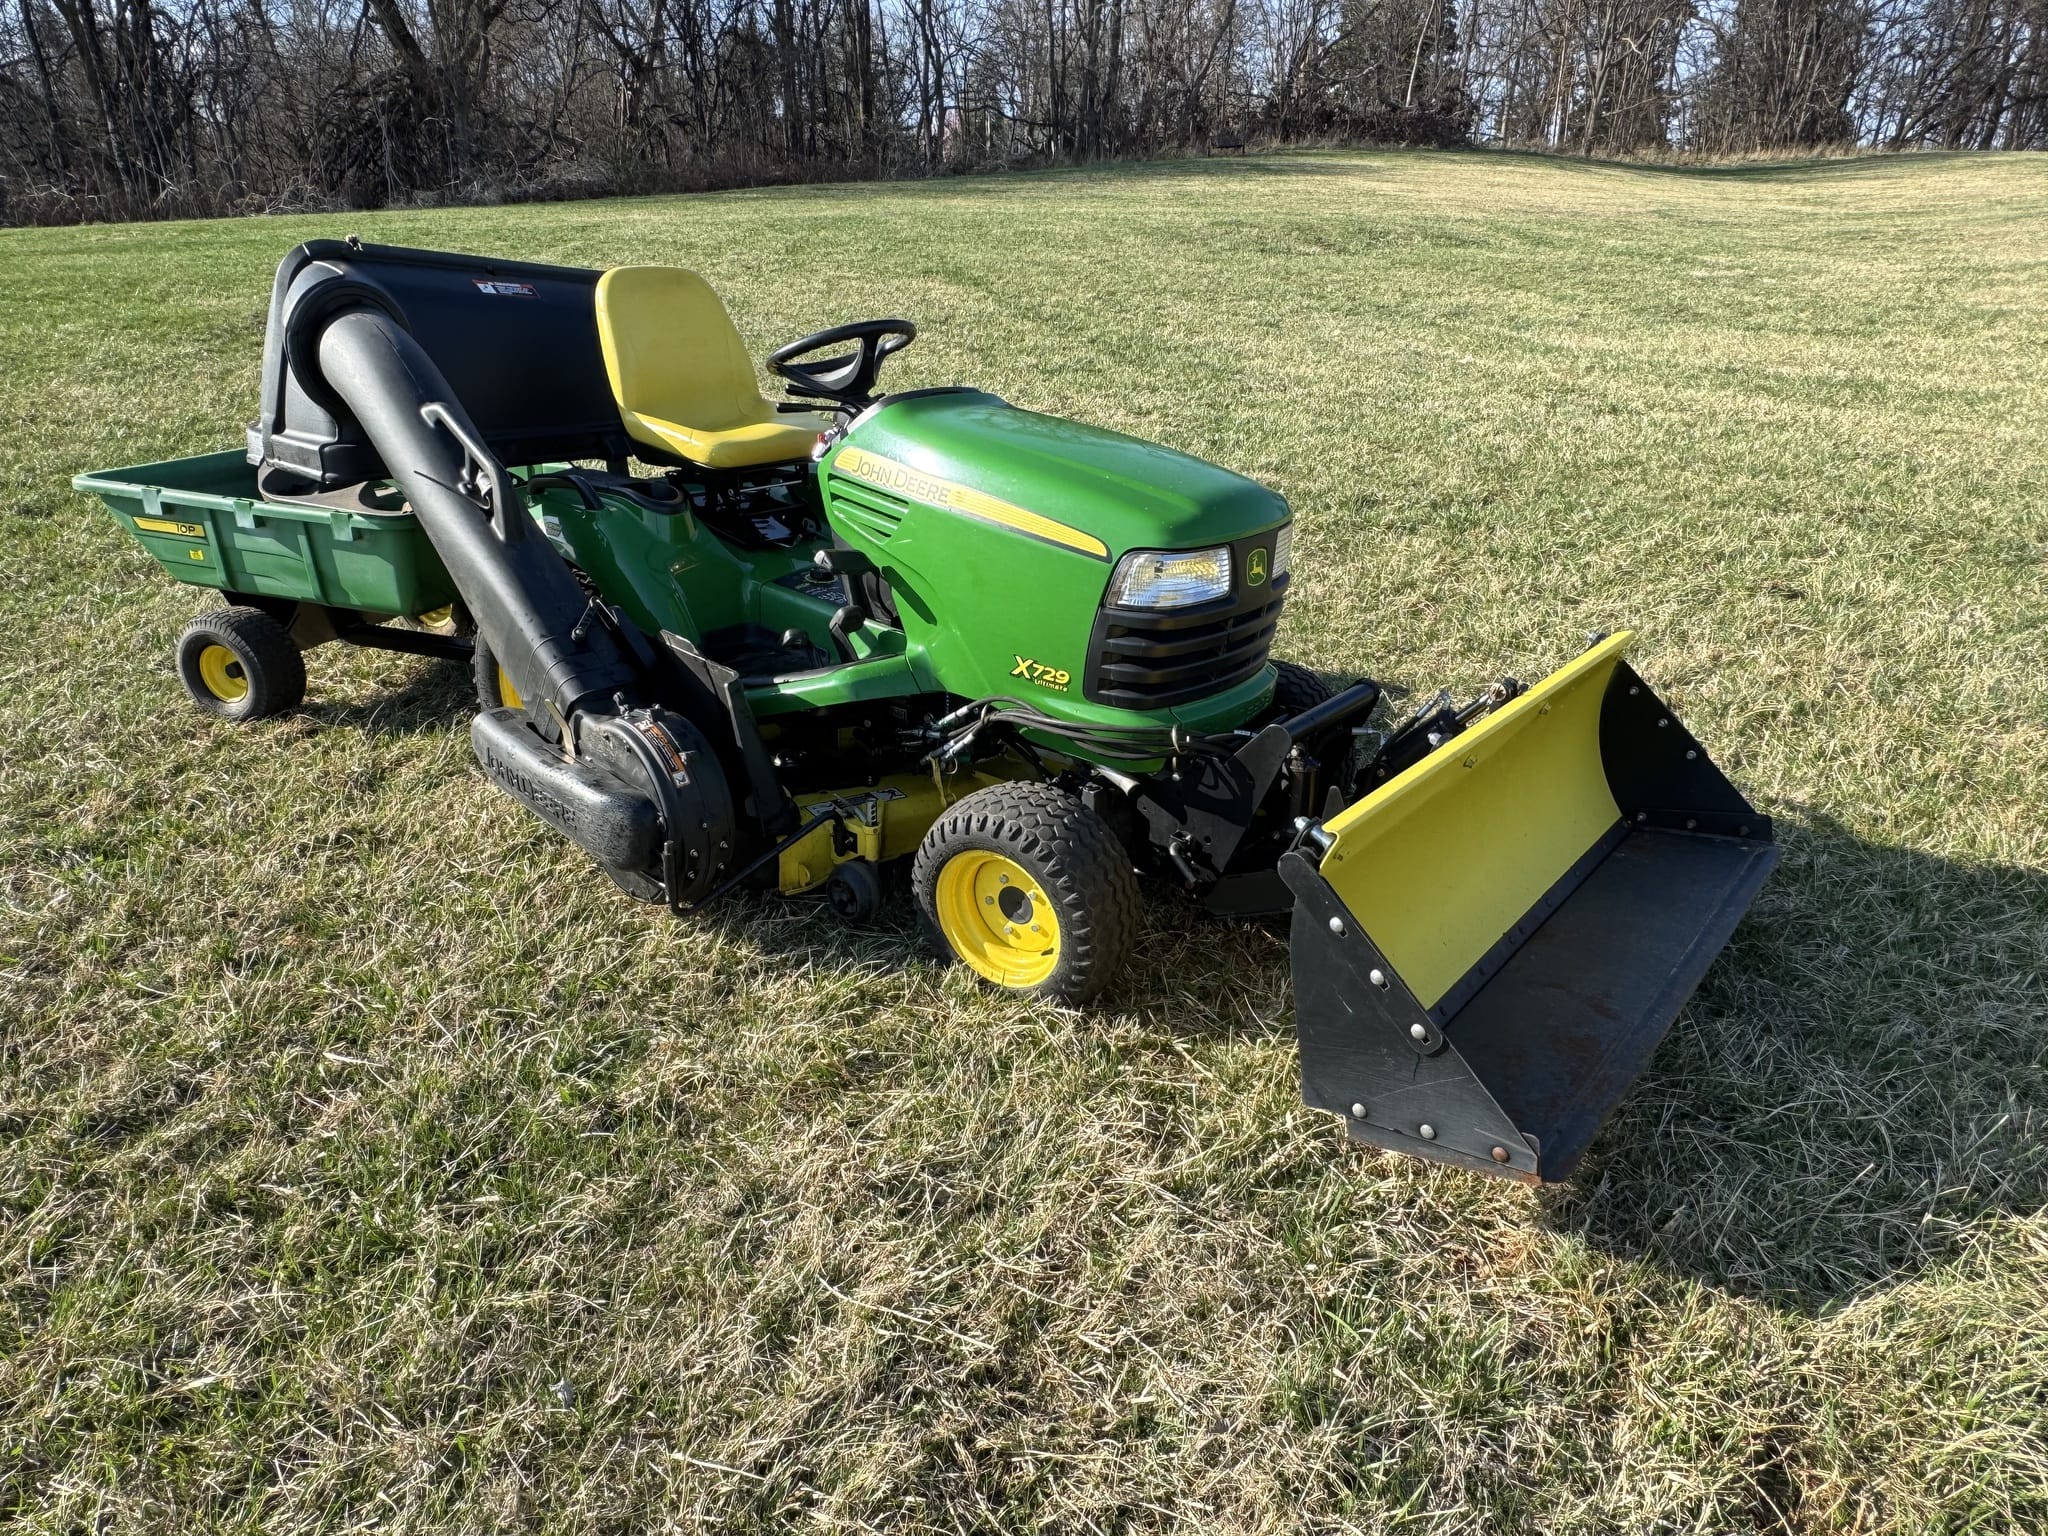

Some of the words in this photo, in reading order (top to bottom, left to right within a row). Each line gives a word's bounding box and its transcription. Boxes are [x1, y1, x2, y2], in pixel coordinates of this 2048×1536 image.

[852, 455, 892, 483] JOHN
[894, 470, 950, 504] DEERE
[175, 523, 196, 534] 10P
[1010, 655, 1070, 685] X729
